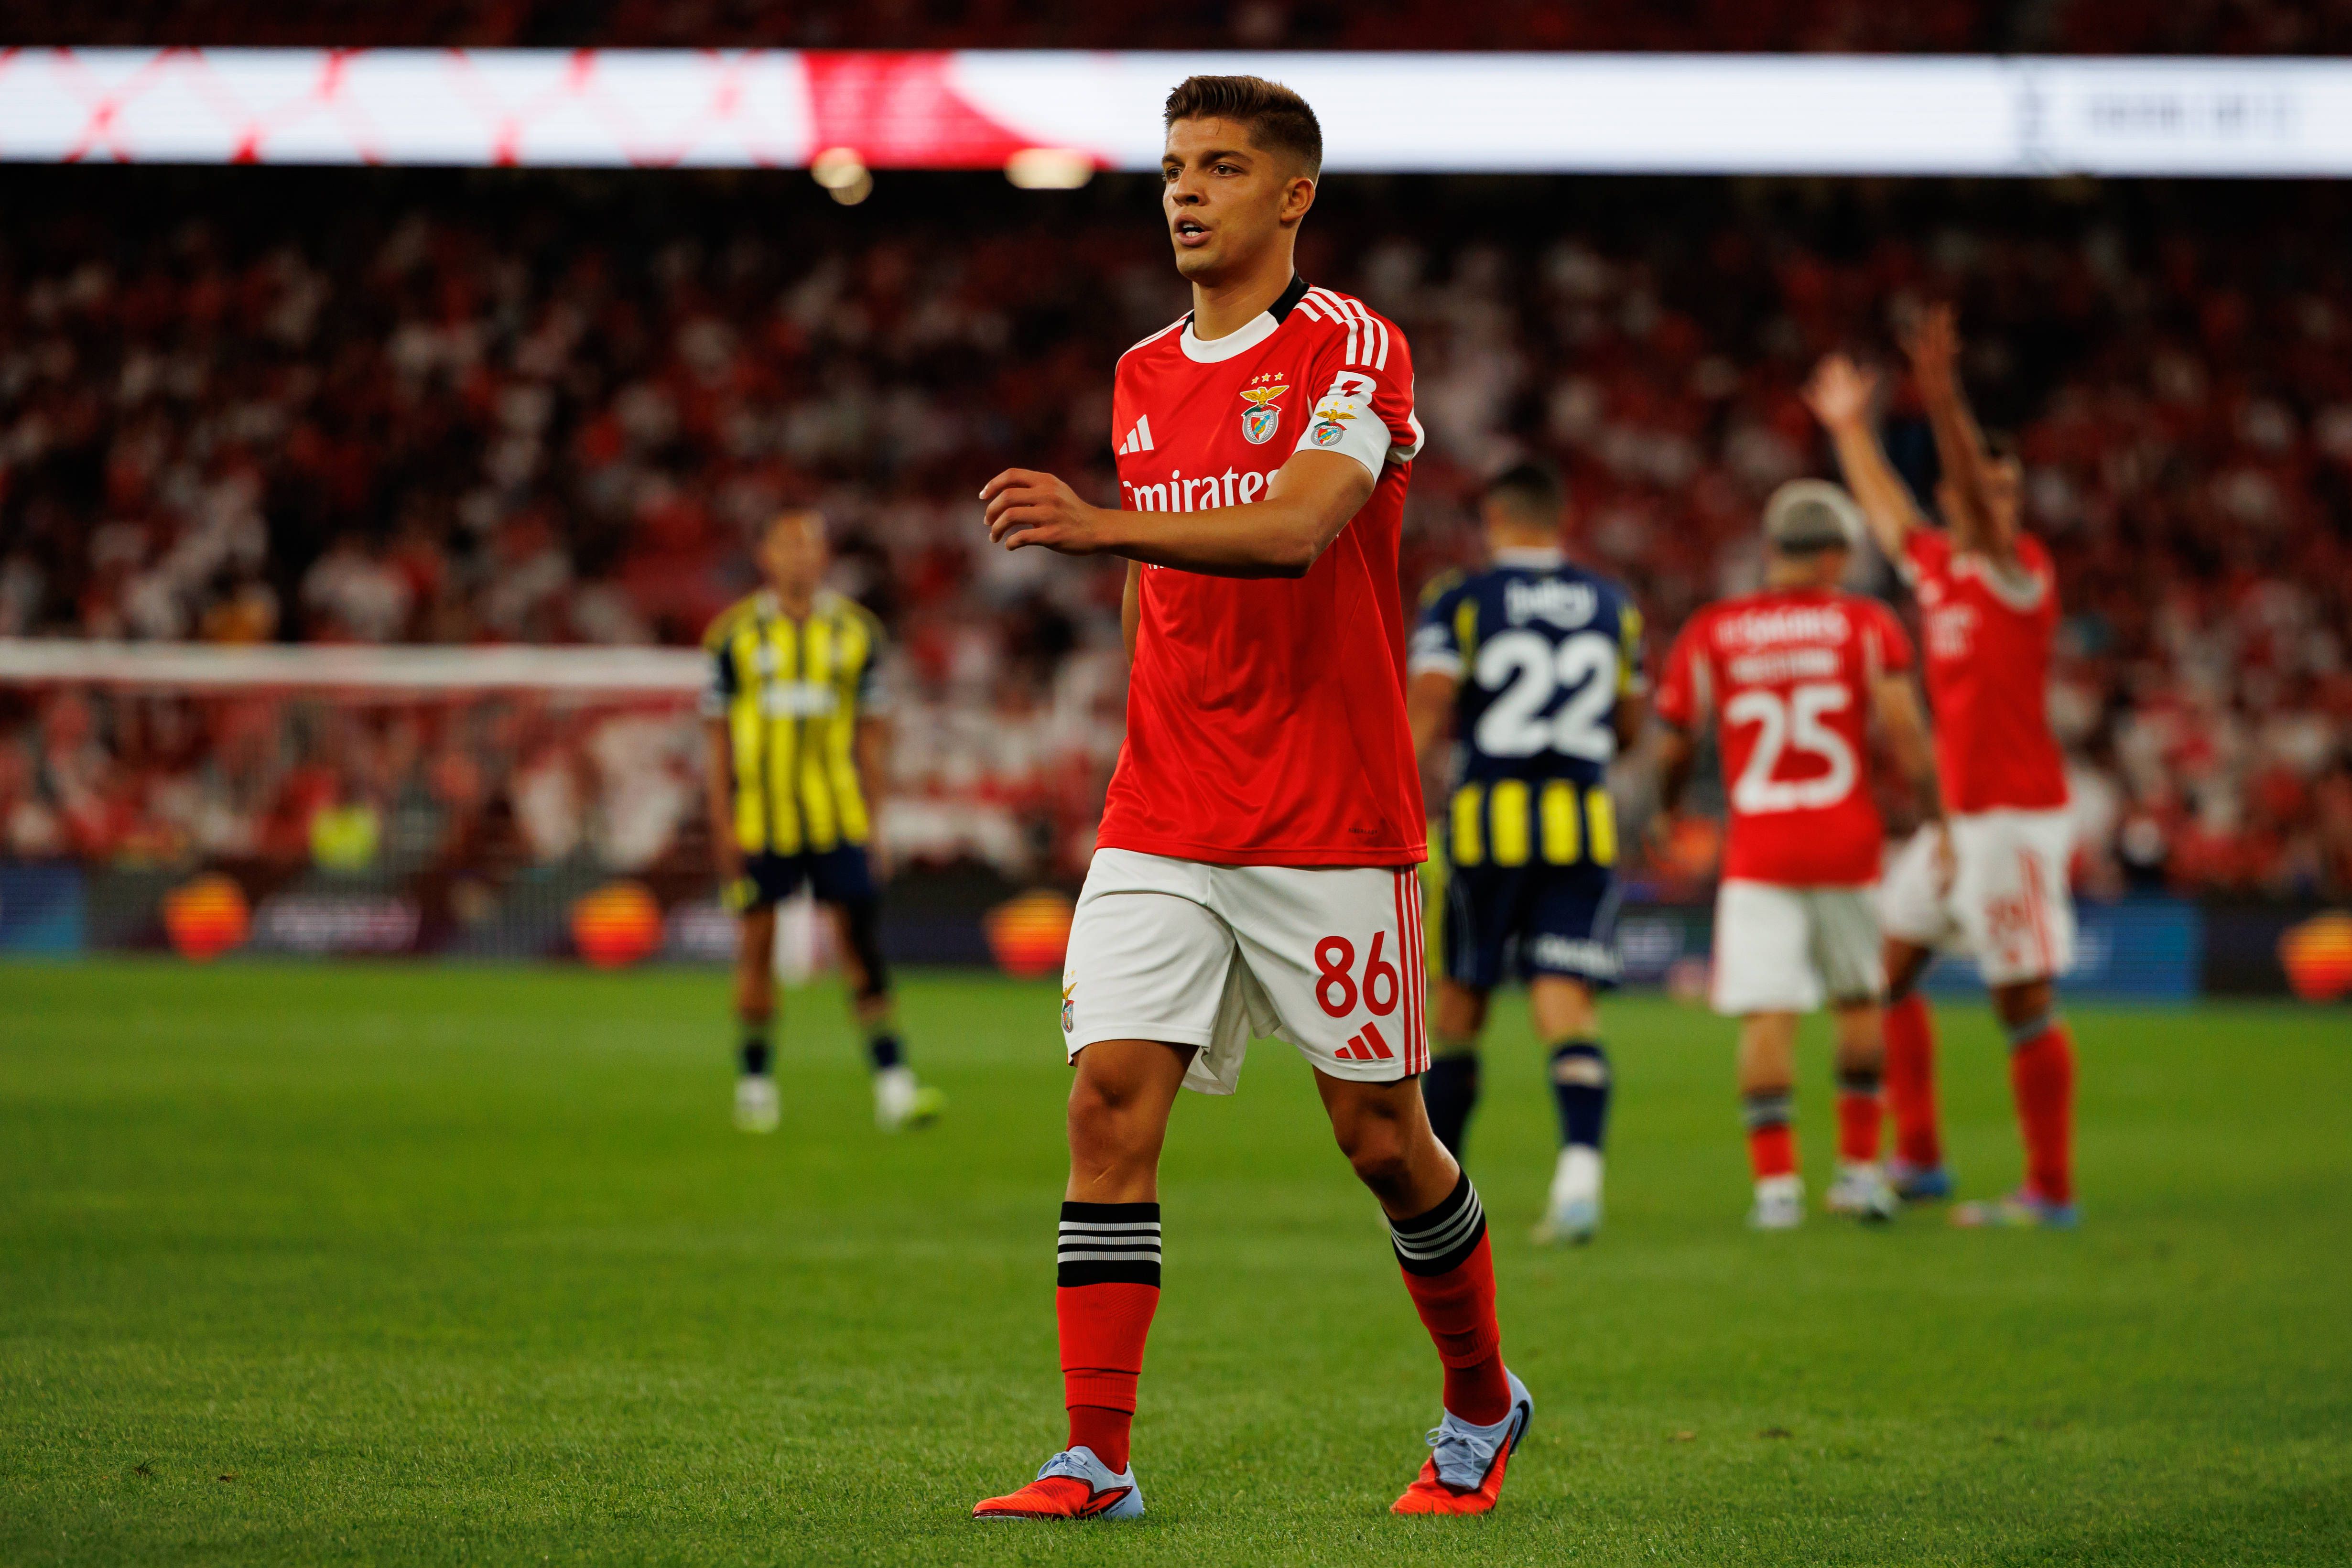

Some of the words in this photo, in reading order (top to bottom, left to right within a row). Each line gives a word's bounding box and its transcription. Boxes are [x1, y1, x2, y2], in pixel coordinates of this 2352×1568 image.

[1122, 465, 1280, 513] mirate
[1475, 629, 1618, 761] 22
[1724, 682, 1858, 814] 25
[1314, 930, 1399, 1018] 86
